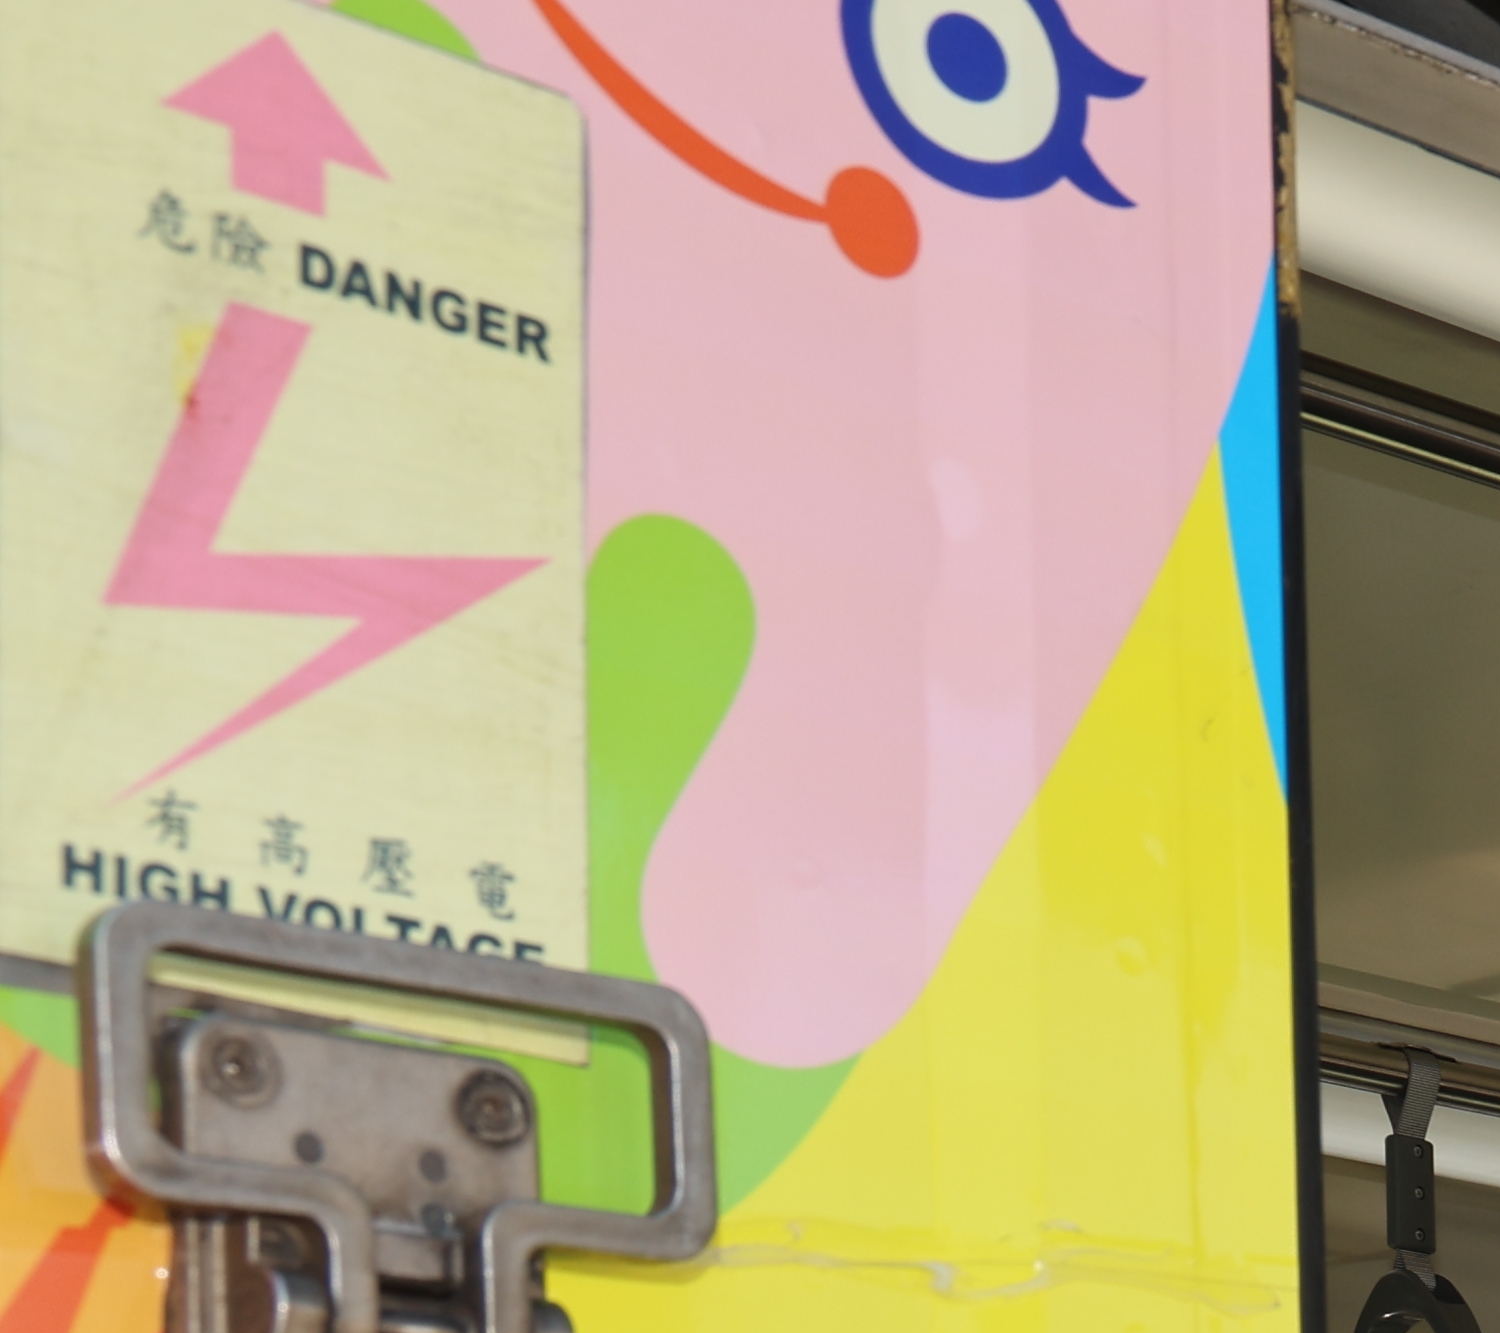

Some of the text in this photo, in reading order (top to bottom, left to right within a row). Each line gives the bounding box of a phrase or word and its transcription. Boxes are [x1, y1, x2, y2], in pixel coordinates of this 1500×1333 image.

[137, 189, 271, 275] 危險
[299, 243, 553, 365] DANGER
[61, 842, 231, 910] HIGH
